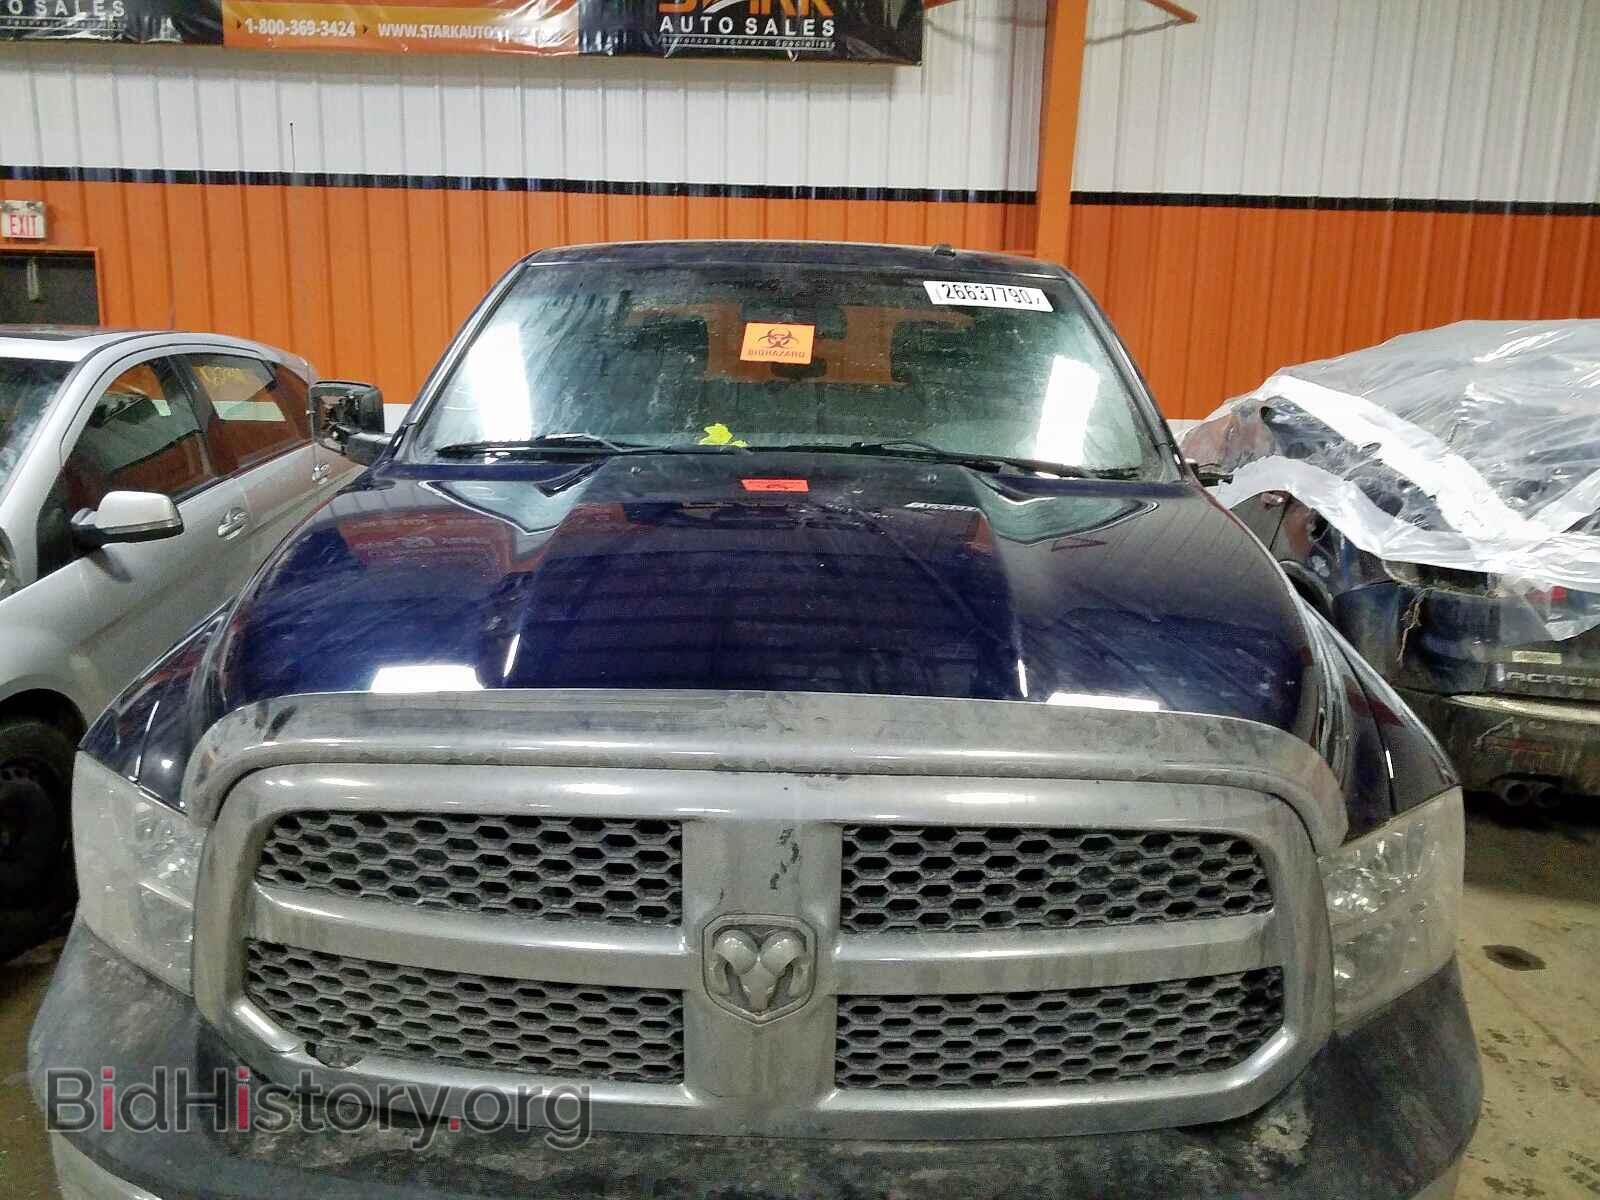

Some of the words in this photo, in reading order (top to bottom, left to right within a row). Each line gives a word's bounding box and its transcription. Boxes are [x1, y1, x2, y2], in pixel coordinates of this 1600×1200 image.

[34, 0, 125, 17] SALES
[244, 18, 356, 37] 1-800-369-3424
[659, 15, 734, 34] AUTO
[744, 17, 835, 37] SALES
[9, 214, 37, 236] EXIT
[747, 349, 806, 359] BIOHAZARD
